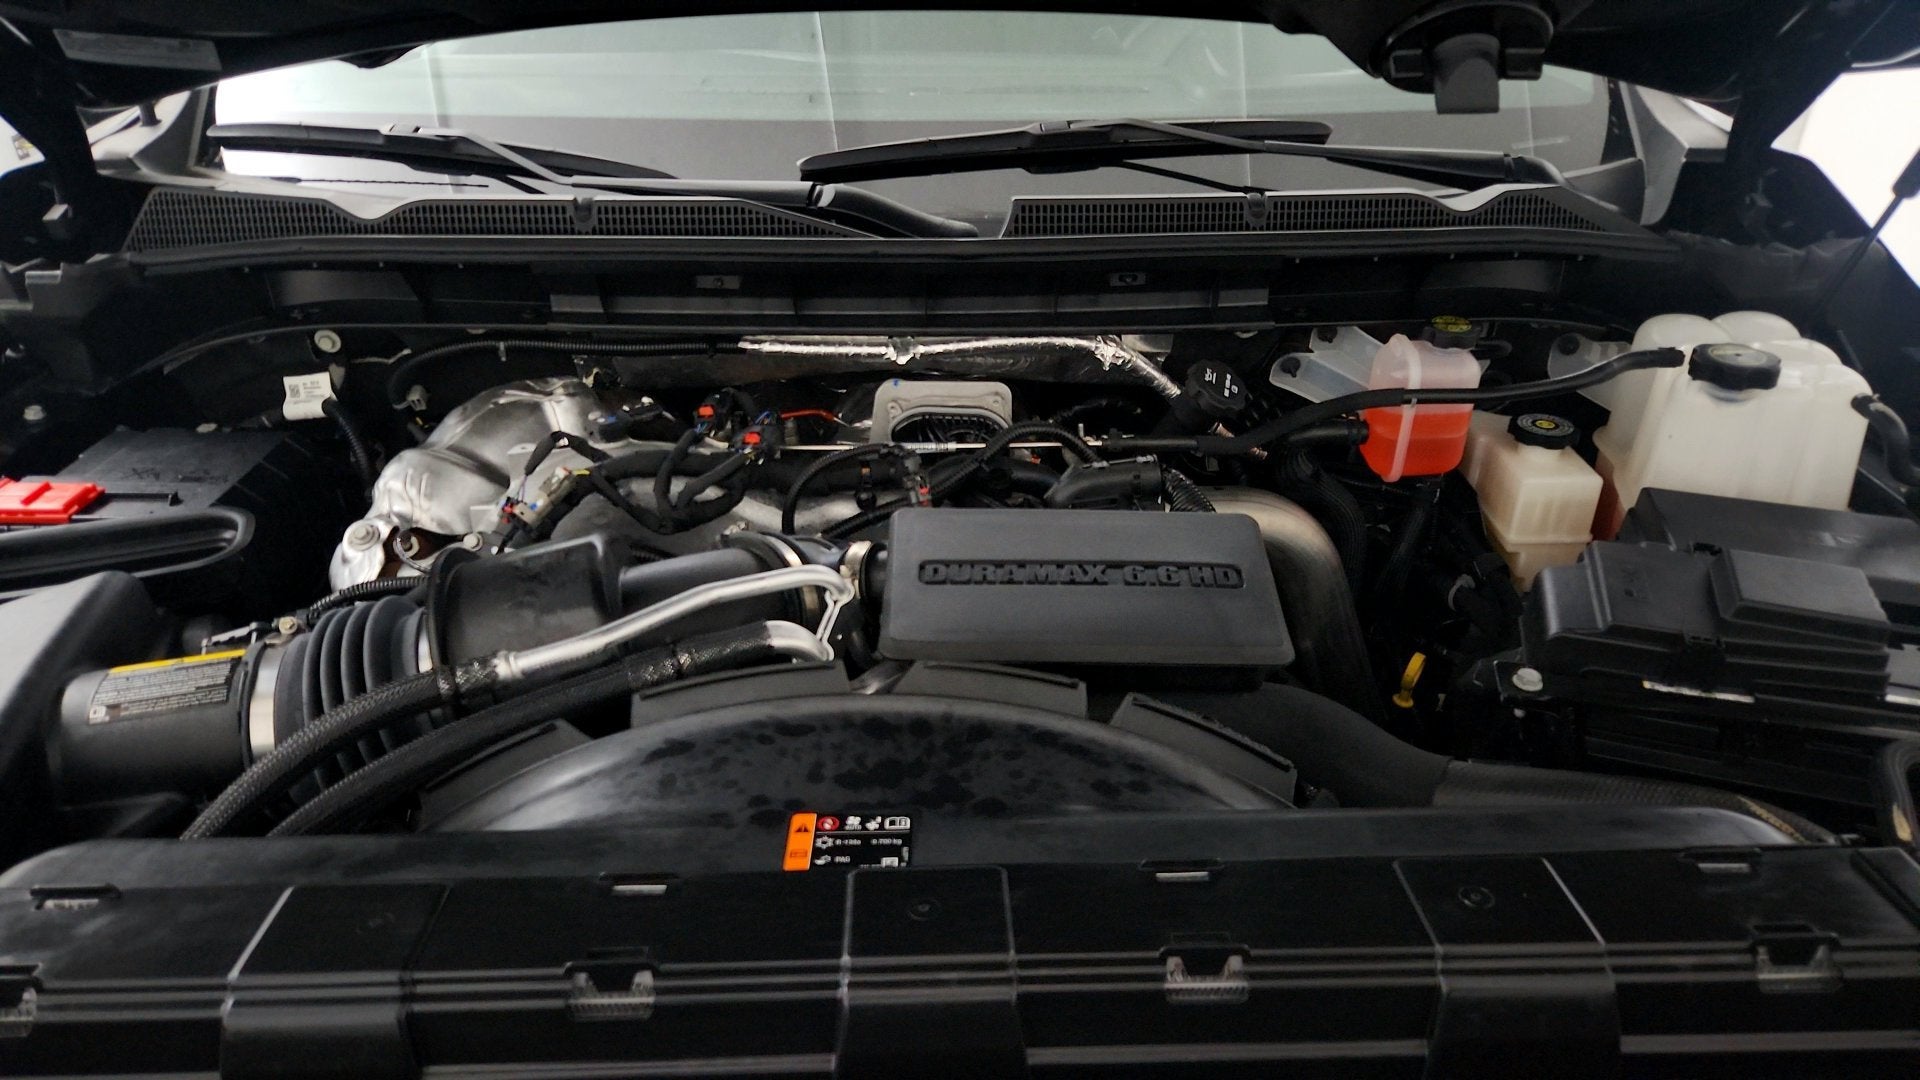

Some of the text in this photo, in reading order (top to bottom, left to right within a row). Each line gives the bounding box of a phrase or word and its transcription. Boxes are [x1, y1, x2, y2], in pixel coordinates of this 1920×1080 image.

[924, 563, 1242, 588] DURAMAX 6.6 HD
